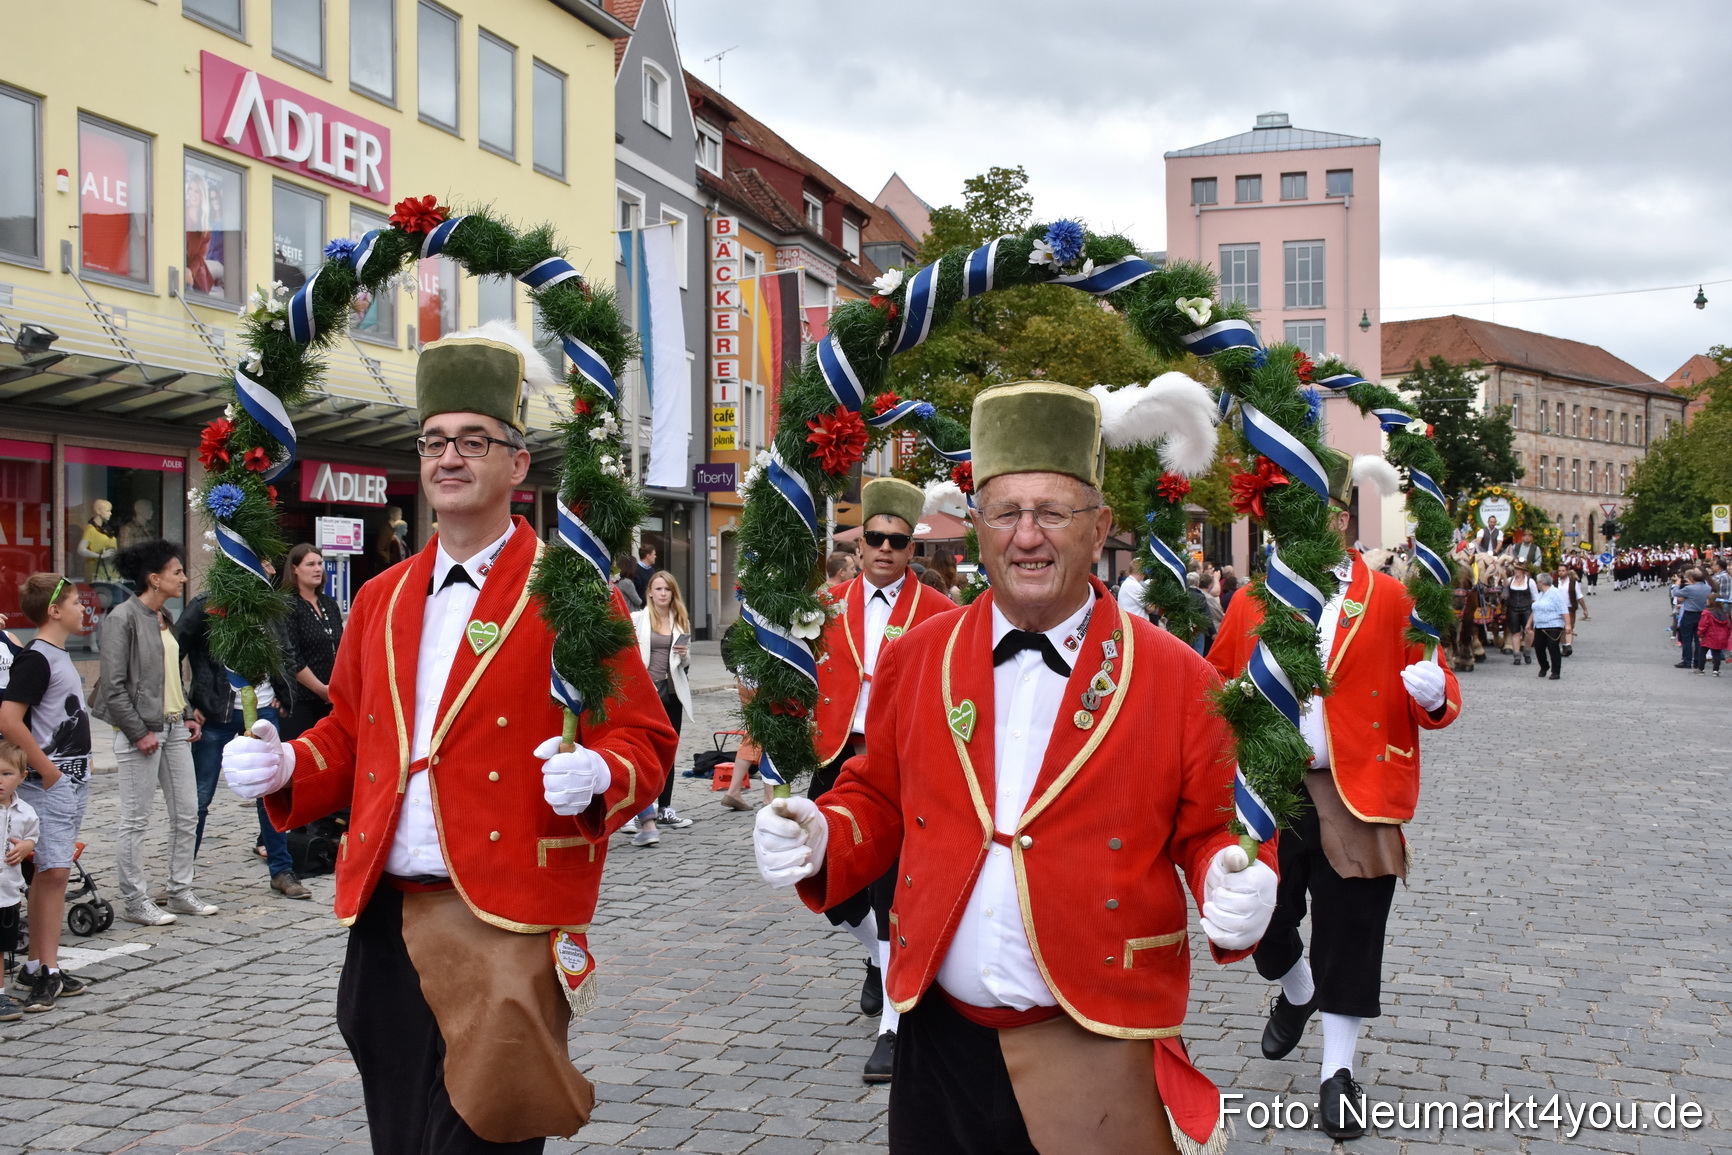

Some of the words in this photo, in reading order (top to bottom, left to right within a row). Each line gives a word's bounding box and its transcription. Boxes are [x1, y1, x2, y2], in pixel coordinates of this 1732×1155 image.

[223, 71, 384, 192] ADLER
[282, 245, 303, 262] SEITE
[716, 219, 731, 400] BÄCKEREI
[714, 409, 734, 423] café
[714, 434, 734, 447] plank
[162, 459, 182, 468] ADLER
[309, 463, 388, 504] ADLER
[698, 470, 733, 486] liberty
